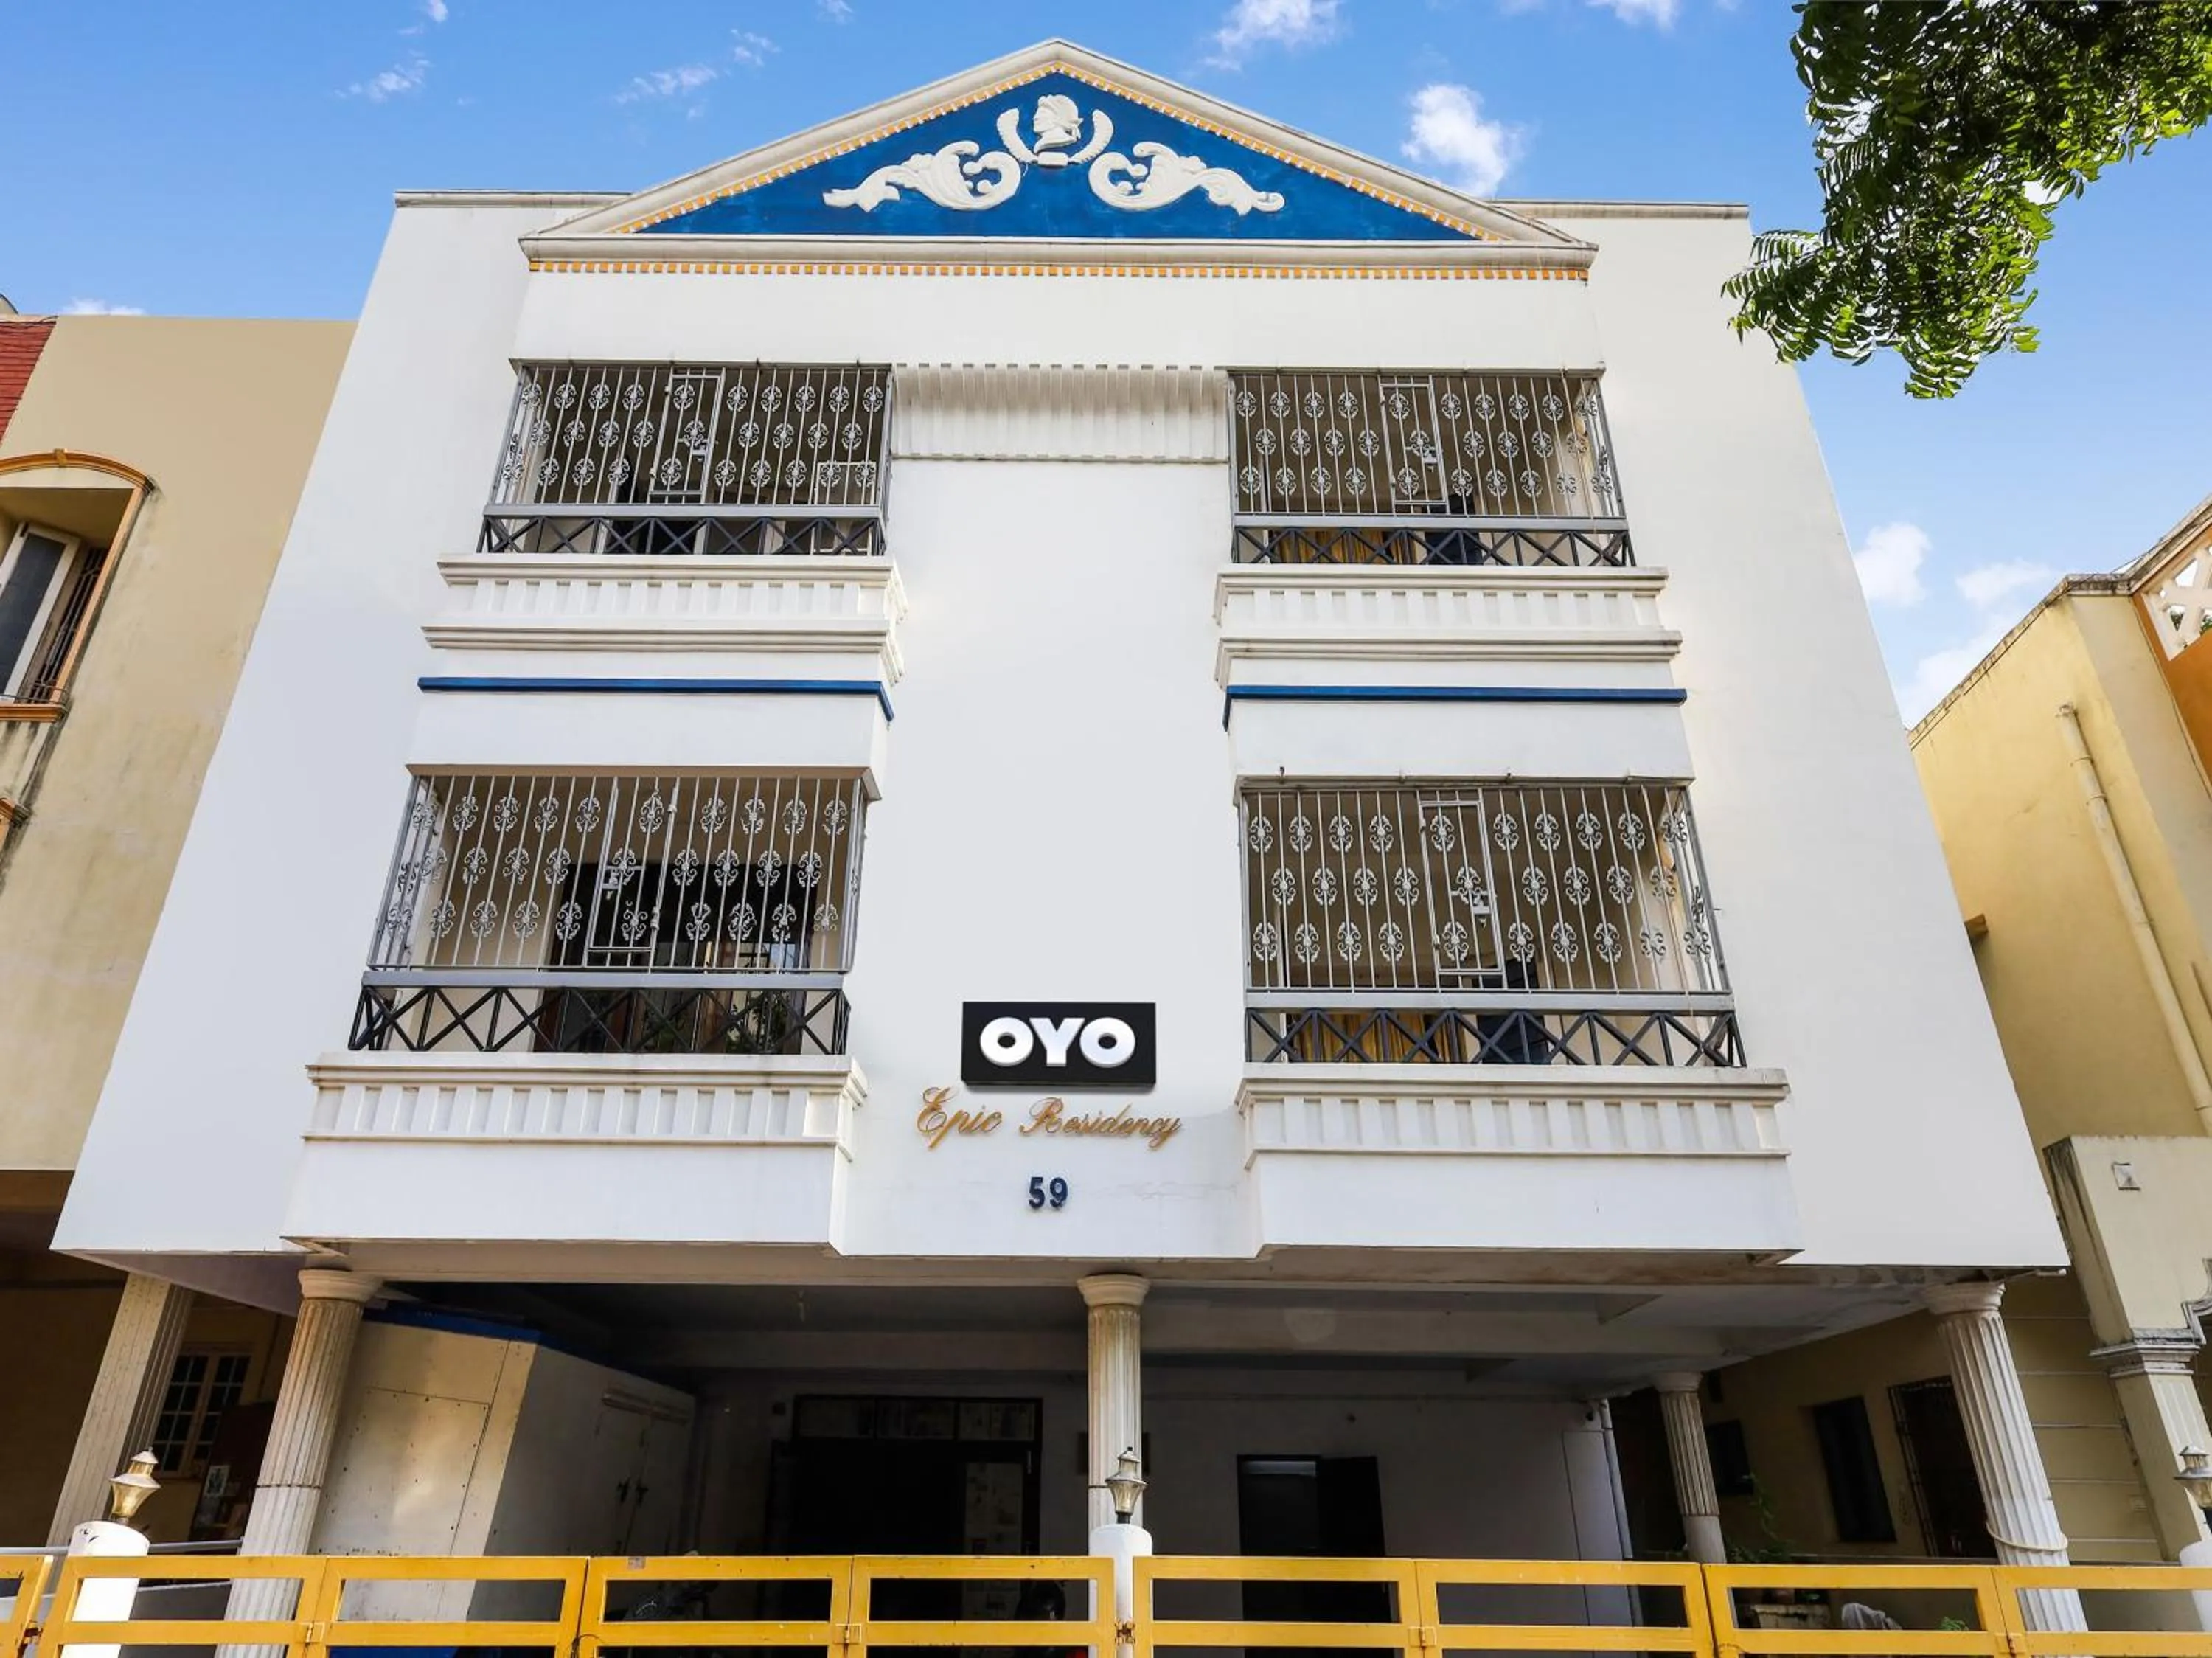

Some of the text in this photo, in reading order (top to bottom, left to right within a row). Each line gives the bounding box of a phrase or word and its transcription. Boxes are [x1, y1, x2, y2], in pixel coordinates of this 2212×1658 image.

[979, 1016, 1136, 1068] OYO
[917, 1086, 1180, 1151] Epic Residency
[1028, 1176, 1068, 1209] 59
